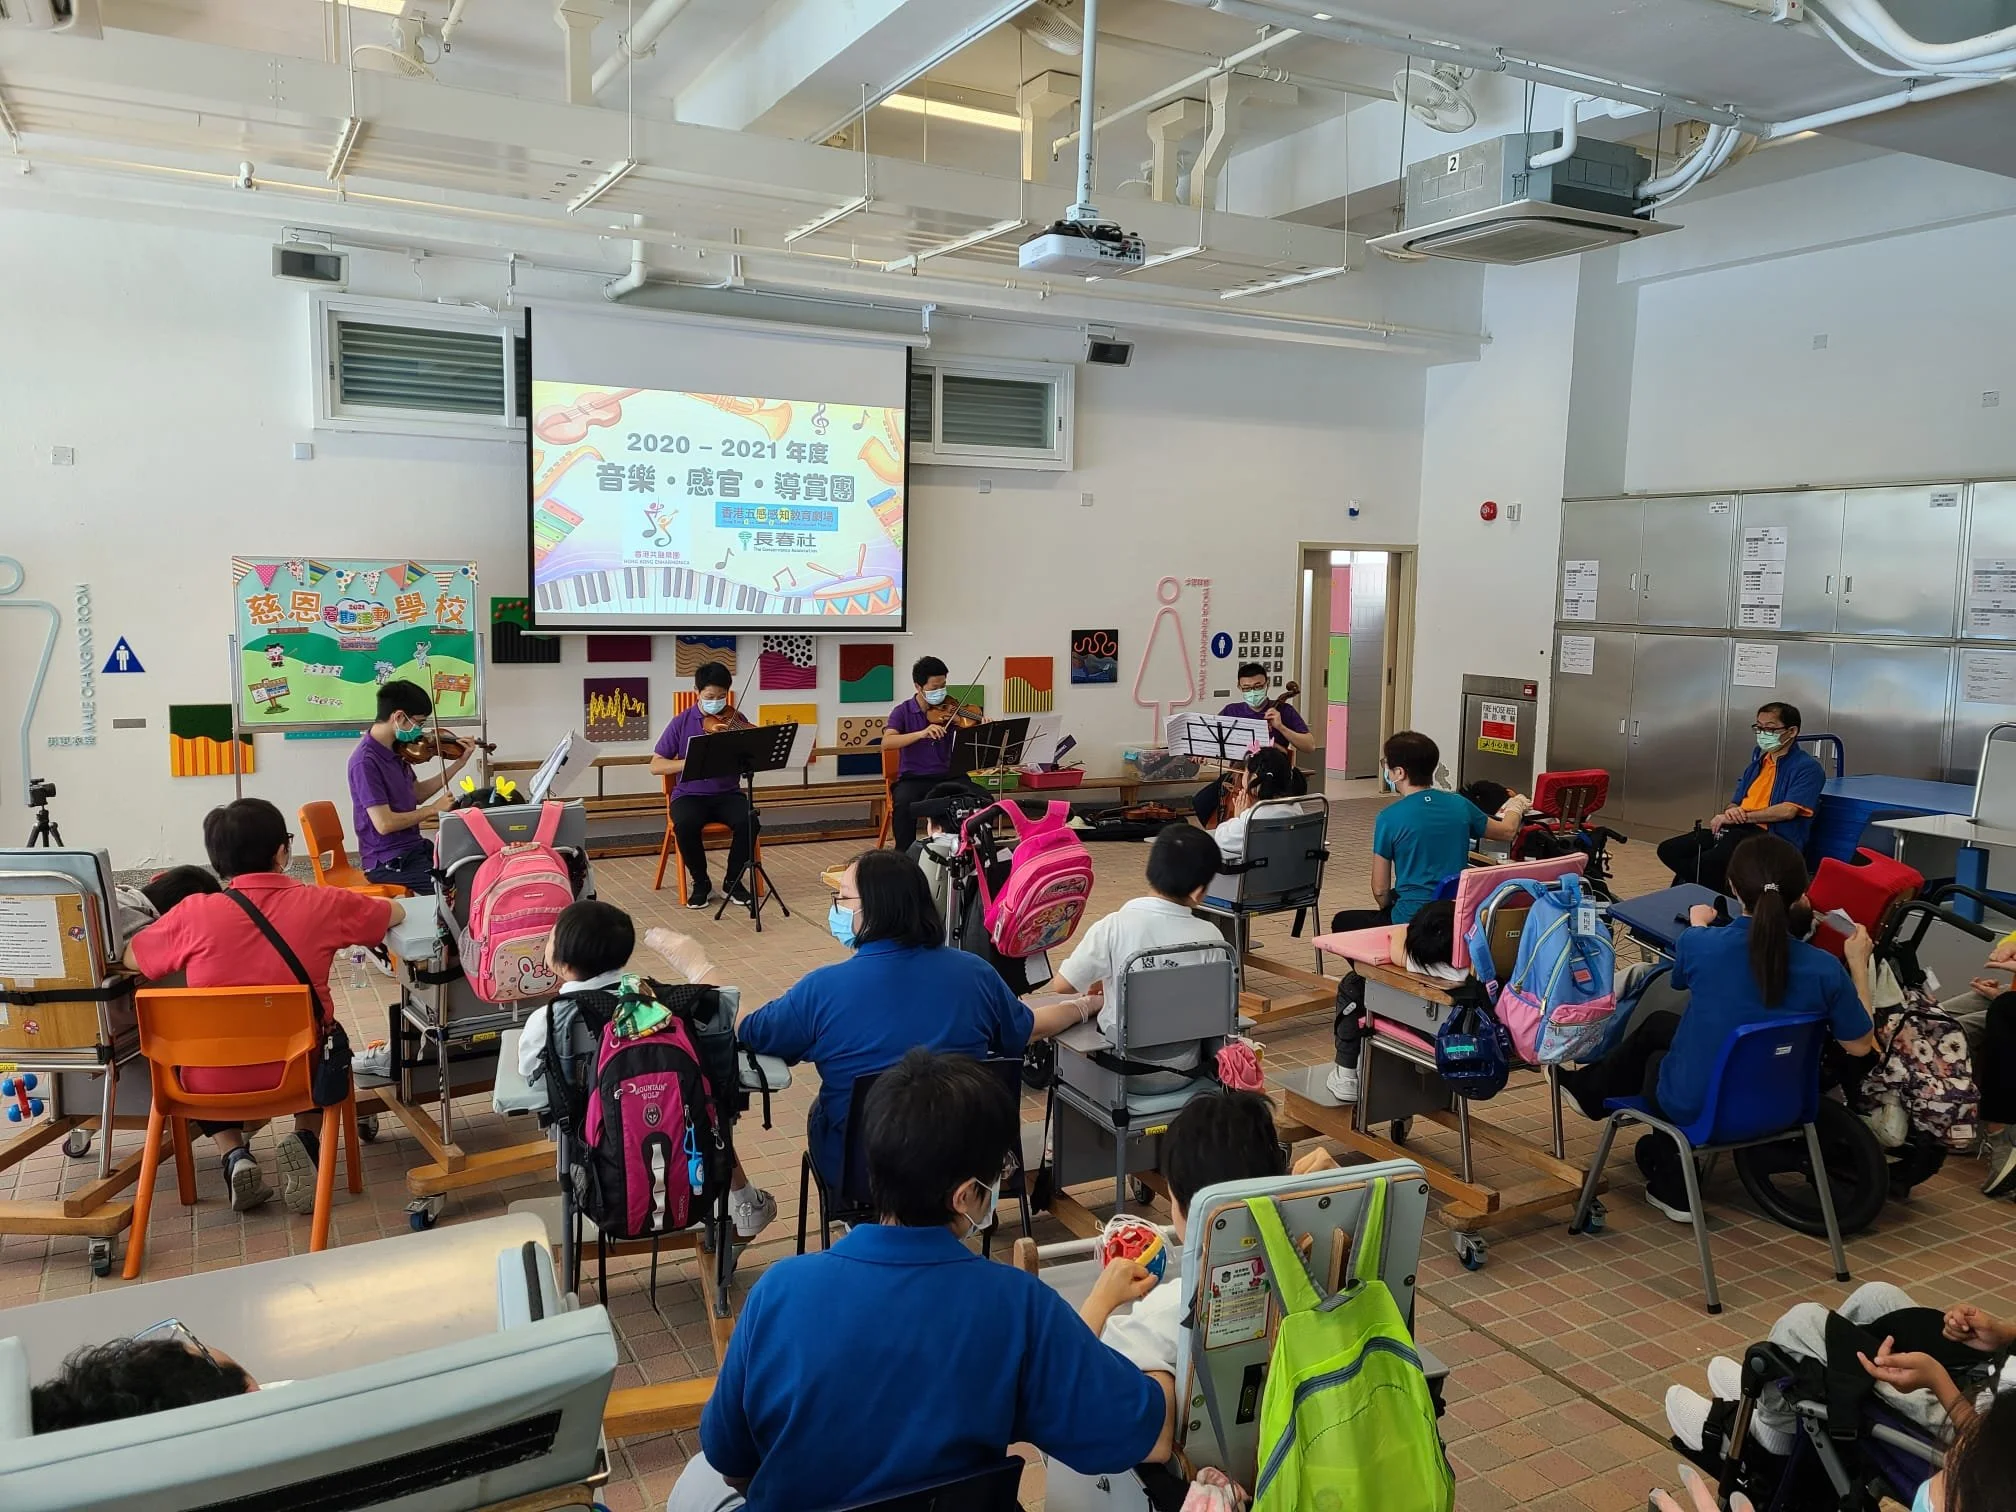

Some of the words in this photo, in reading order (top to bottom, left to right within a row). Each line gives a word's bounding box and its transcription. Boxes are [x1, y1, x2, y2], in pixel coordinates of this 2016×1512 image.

[1449, 156, 1457, 171] 2
[627, 433, 690, 454] 2020
[721, 439, 777, 460] 2021
[785, 440, 829, 465] 年度
[754, 532, 816, 548] 長春社
[76, 583, 91, 623] ROOM
[246, 590, 322, 624] 慈恩
[394, 591, 467, 624] 學校
[323, 605, 390, 625] 暑期活動
[79, 627, 95, 698] CHANGING
[82, 701, 96, 734] MALE
[1483, 704, 1491, 712] FIRE
[1493, 705, 1505, 714] HOSE
[264, 996, 273, 1007] 5
[635, 1084, 665, 1095] MOUNTAIN
[642, 1091, 660, 1100] WOLF
